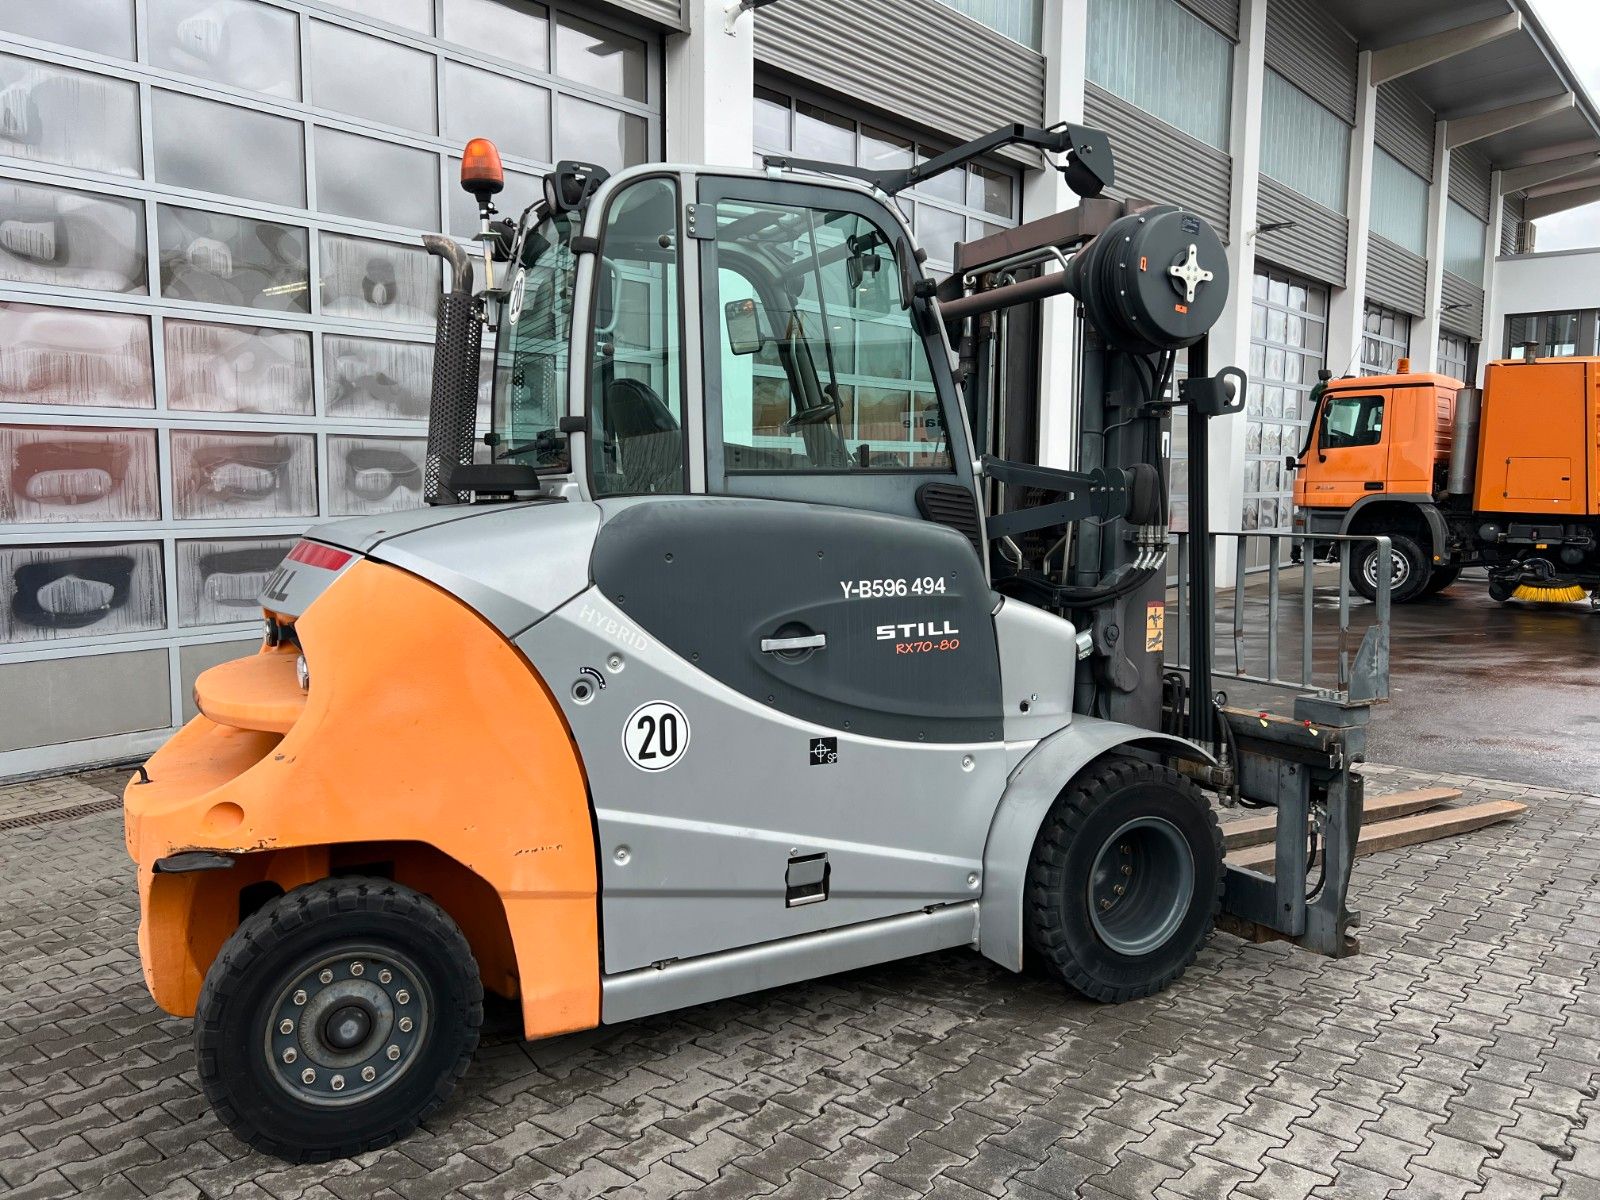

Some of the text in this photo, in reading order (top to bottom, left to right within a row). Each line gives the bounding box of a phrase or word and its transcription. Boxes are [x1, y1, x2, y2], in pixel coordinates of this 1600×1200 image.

[511, 277, 523, 315] 20
[840, 577, 946, 598] Y-B596 494
[579, 605, 647, 650] HYBRID
[877, 621, 958, 640] STILL
[896, 639, 960, 654] RX70-80
[638, 713, 677, 760] 20
[827, 753, 838, 763] SP
